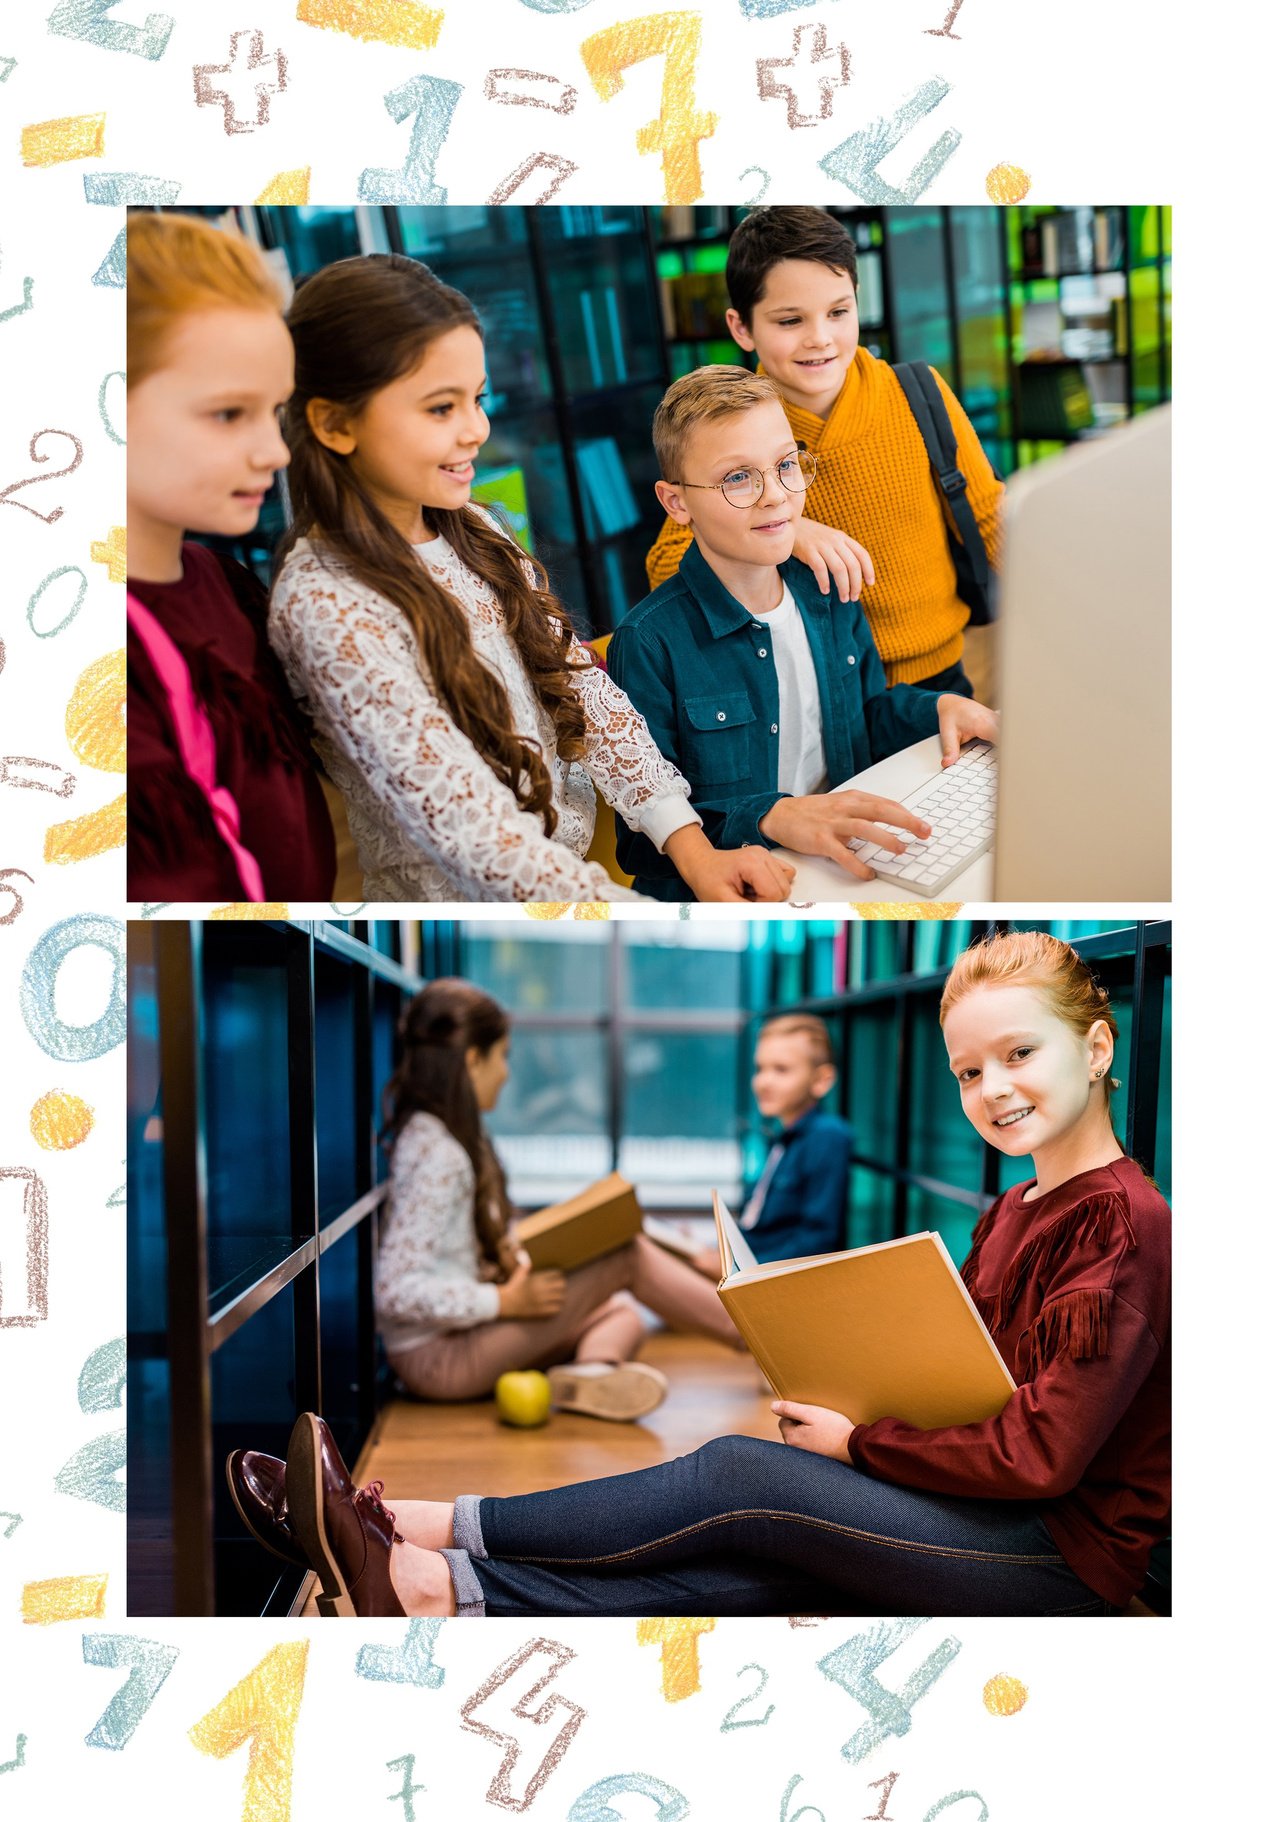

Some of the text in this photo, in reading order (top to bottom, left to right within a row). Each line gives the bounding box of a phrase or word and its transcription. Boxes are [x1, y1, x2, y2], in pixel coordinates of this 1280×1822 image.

[358, 74, 465, 205] 1
[0, 429, 83, 524] 2
[82, 1633, 181, 1751] 7
[187, 1637, 310, 1822] 1
[459, 1636, 588, 1814] 4
[720, 1662, 775, 1734] 2
[862, 1771, 900, 1821] 1
